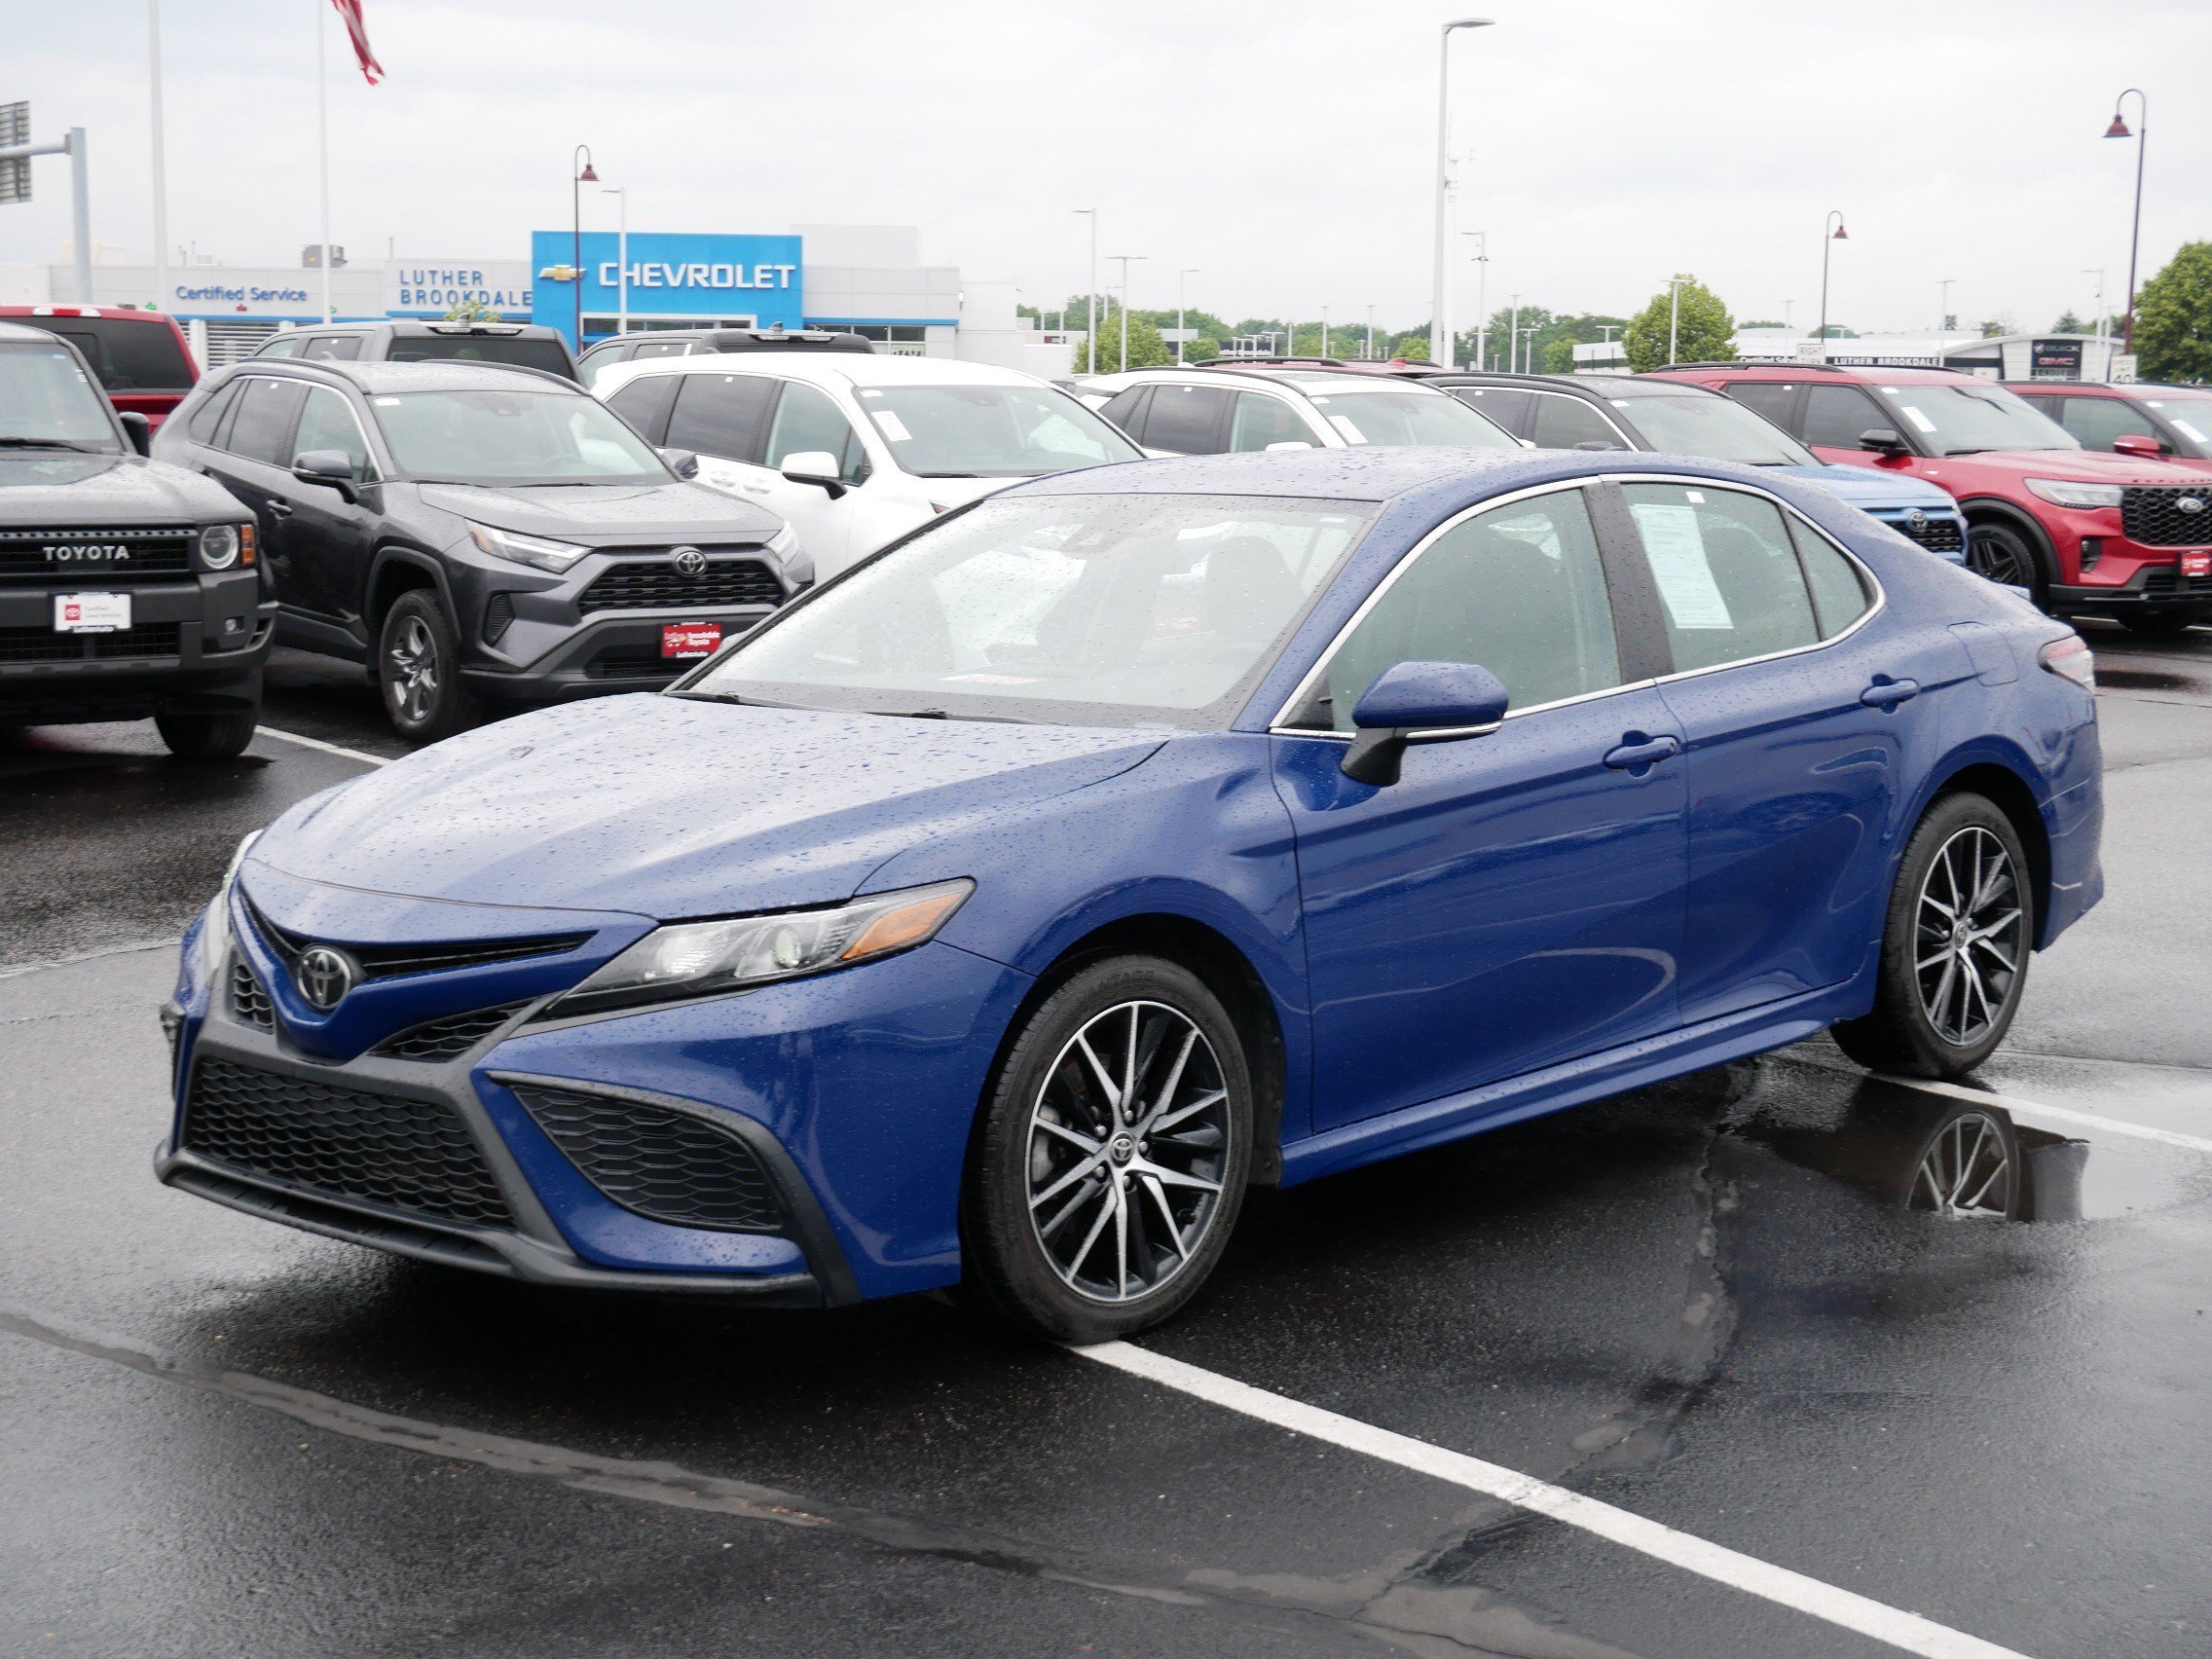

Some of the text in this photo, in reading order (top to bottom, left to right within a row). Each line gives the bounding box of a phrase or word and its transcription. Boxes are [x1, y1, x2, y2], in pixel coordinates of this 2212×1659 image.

[399, 270, 483, 285] LUTHER
[598, 262, 796, 289] CHEVROLET
[176, 284, 308, 301] Certified Service
[400, 289, 533, 306] BROOKDALE
[1834, 356, 1938, 367] LUTHER BROOKDALE
[43, 545, 130, 561] TOYOTA
